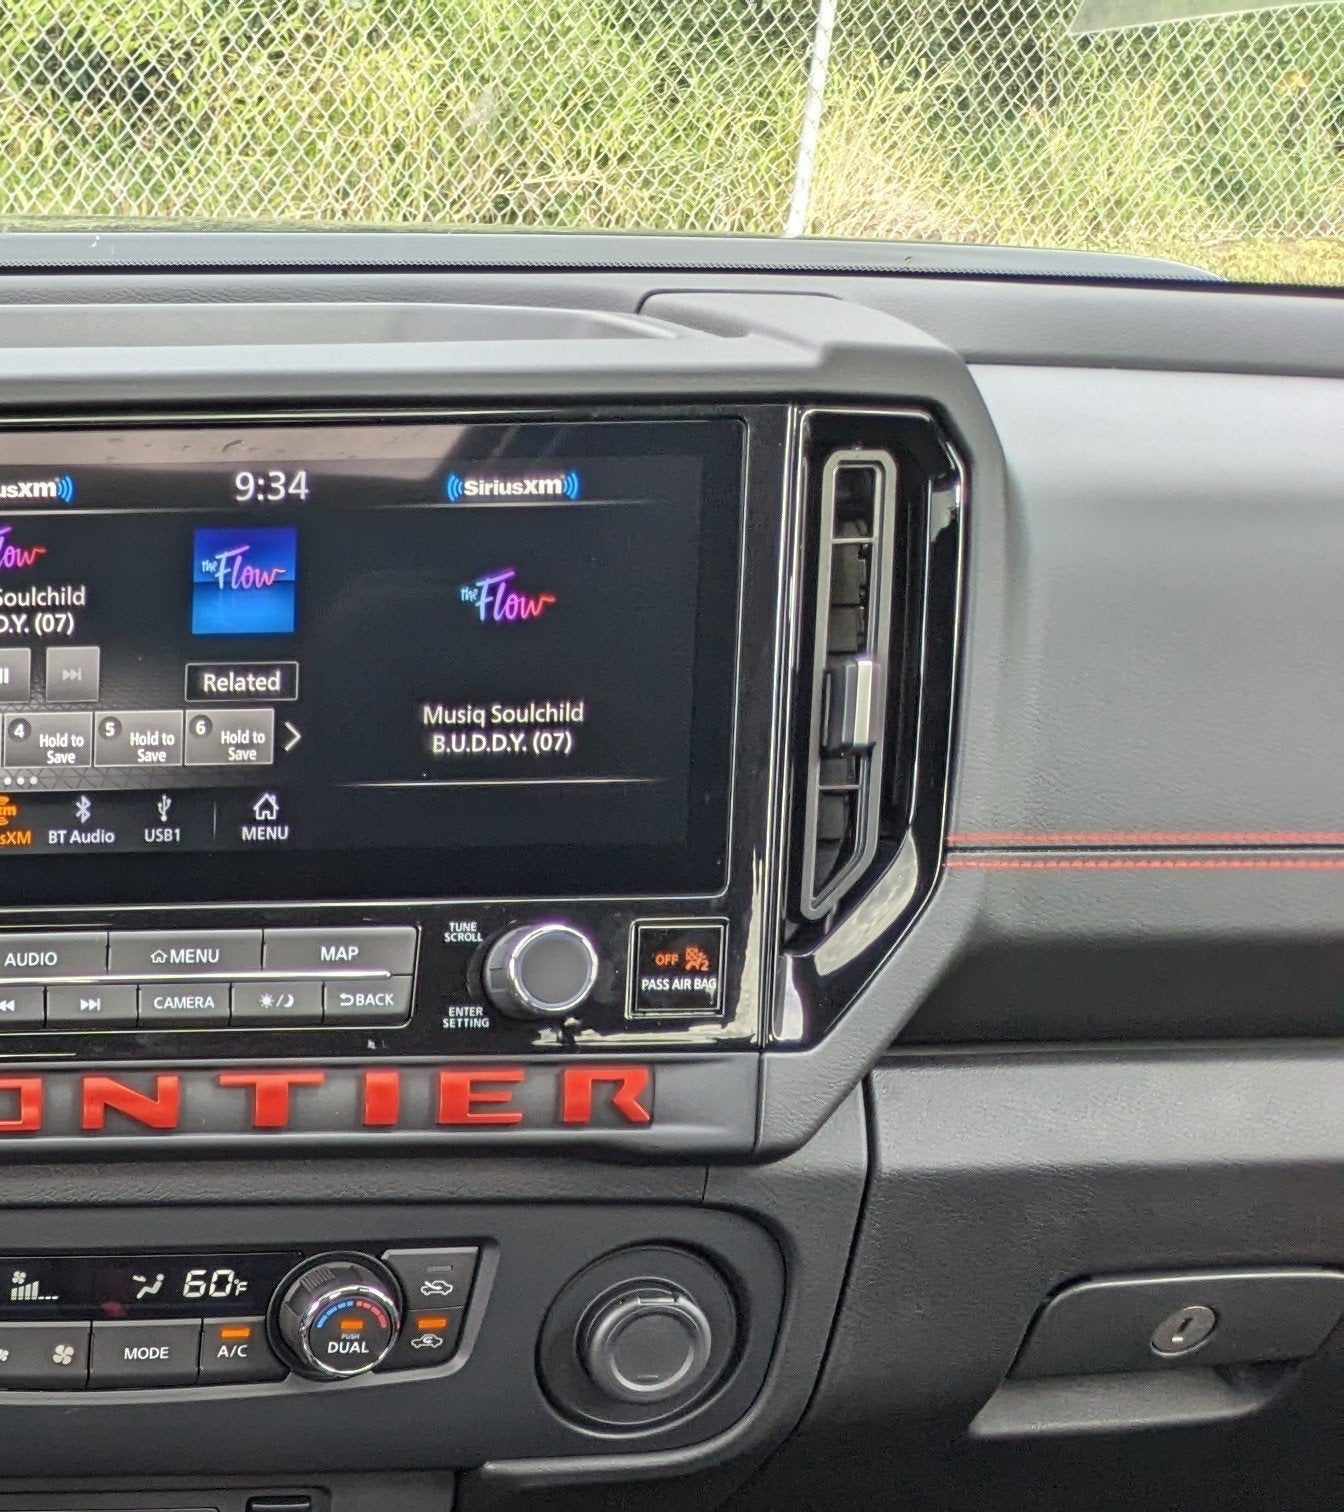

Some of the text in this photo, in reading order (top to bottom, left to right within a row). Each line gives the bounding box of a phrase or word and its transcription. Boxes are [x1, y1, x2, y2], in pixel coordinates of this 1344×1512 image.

[234, 470, 309, 502] 9:34
[214, 545, 287, 590] Flow
[475, 568, 556, 622] Flow
[34, 613, 76, 636] (07)
[203, 672, 281, 692] Related
[423, 702, 584, 727] Musiq Soulchild
[13, 724, 25, 739] 4
[105, 722, 115, 737] 5
[195, 720, 206, 736] 6
[39, 732, 84, 749] Hold to
[129, 731, 175, 747] Hold to
[220, 730, 266, 745] Hold to
[432, 731, 573, 754] B.U.D.D.Y. (07)
[46, 749, 76, 765] Save
[137, 748, 166, 764] Save
[228, 746, 257, 762] Save
[48, 828, 115, 844] BT Audio
[144, 828, 181, 843] USB1
[241, 825, 289, 842] MENU
[448, 922, 478, 933] TUNE
[444, 932, 484, 943] SCROLL
[4, 950, 58, 968] AUDIO
[170, 948, 220, 964] MENU
[320, 946, 359, 963] MAP
[654, 953, 679, 967] OFF
[641, 978, 717, 991] PASS AIR BAG
[153, 995, 215, 1011] CAMERA
[355, 993, 394, 1008] BACK
[448, 1006, 484, 1018] ENTER
[442, 1017, 490, 1029] SETTING
[124, 1346, 169, 1361] MODE
[217, 1344, 248, 1359] A/C
[327, 1340, 370, 1355] DUAL
